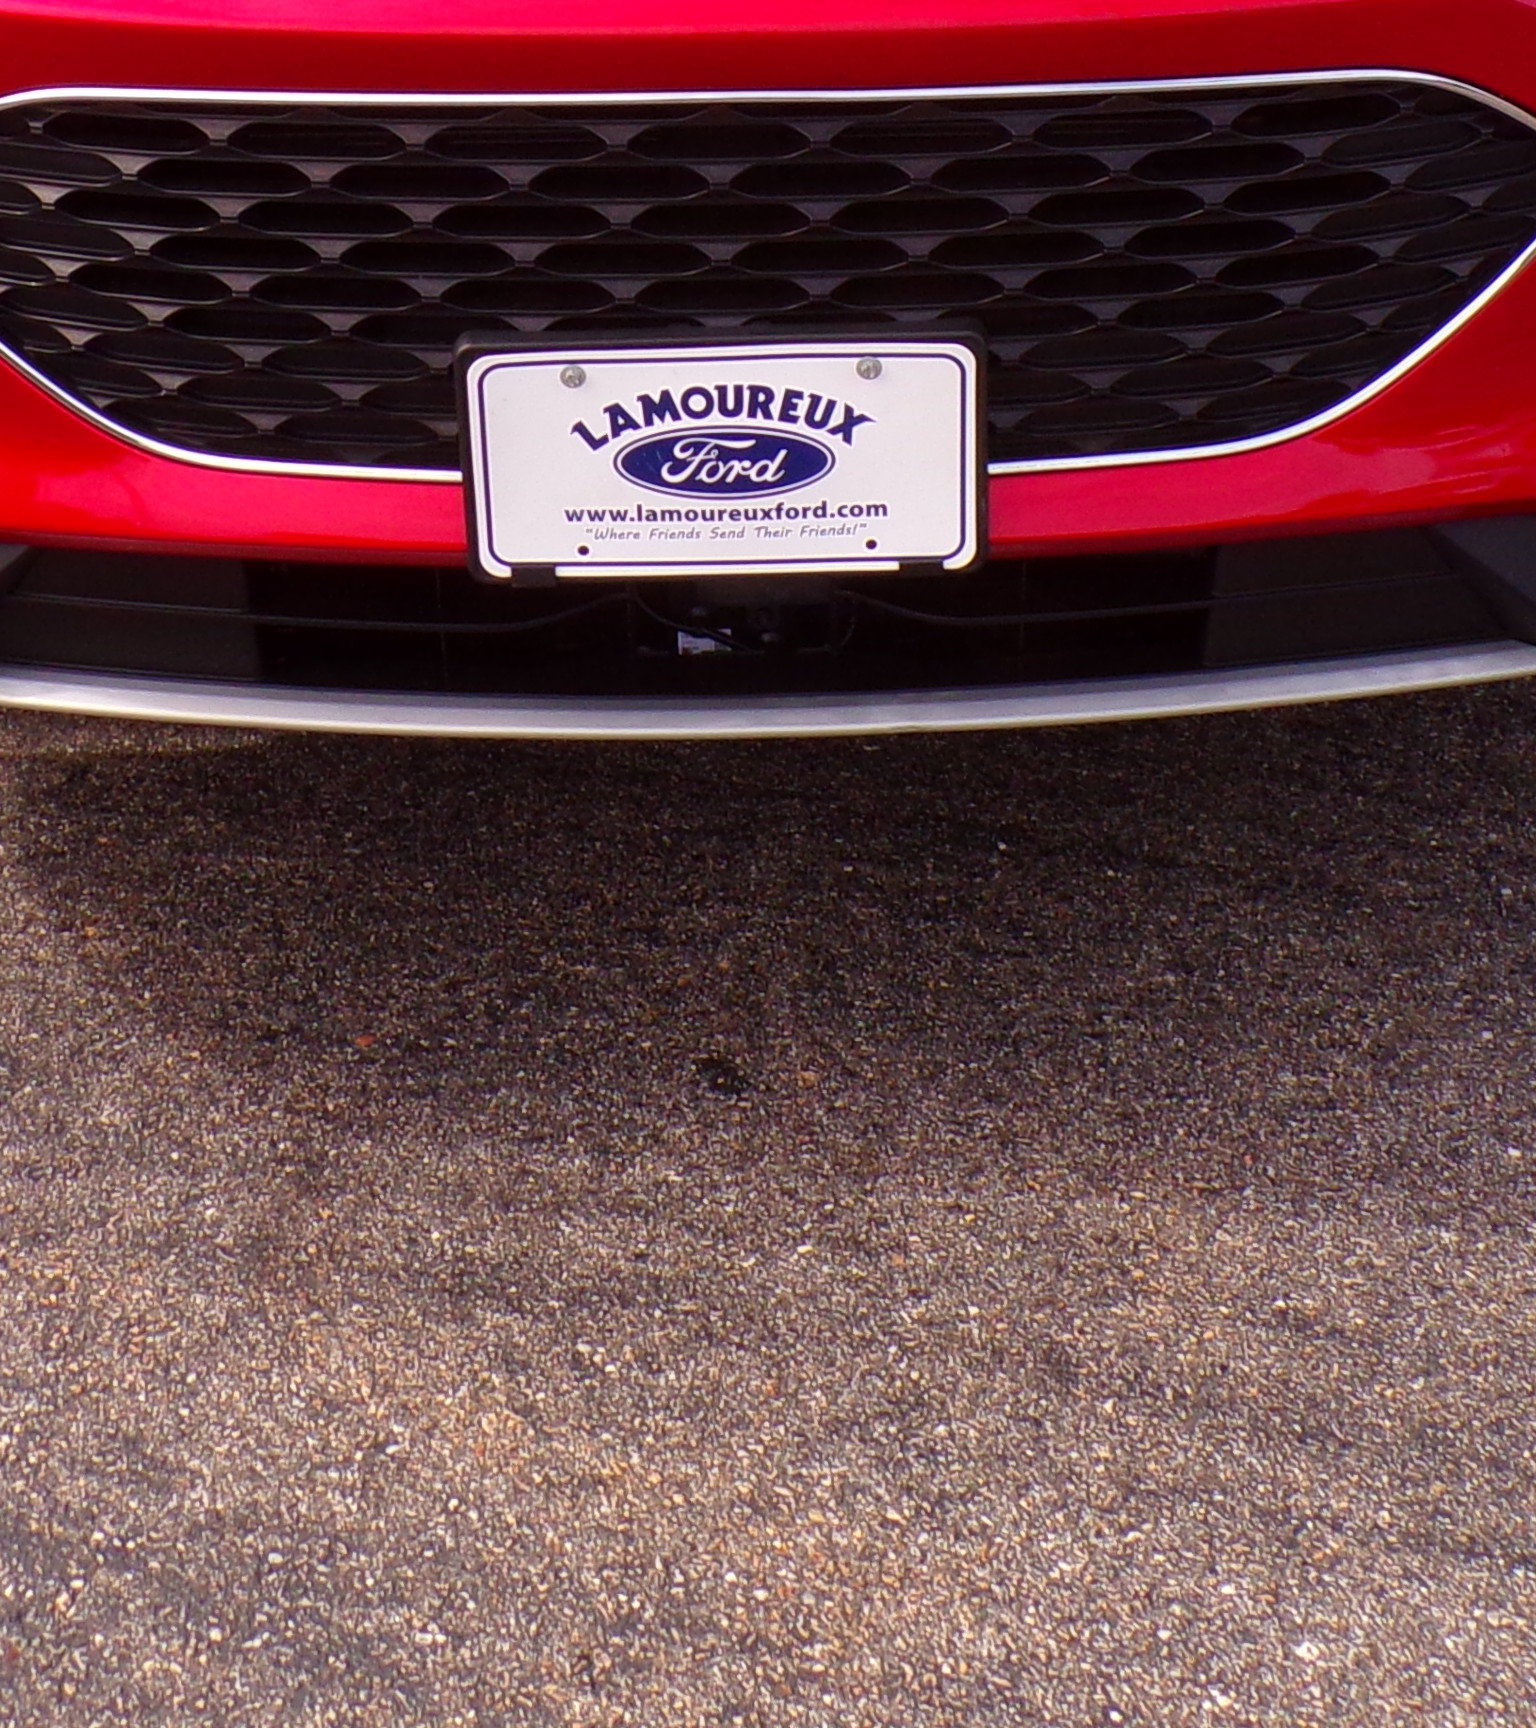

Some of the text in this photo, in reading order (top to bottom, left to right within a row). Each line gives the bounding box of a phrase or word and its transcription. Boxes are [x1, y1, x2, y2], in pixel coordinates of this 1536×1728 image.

[570, 383, 877, 452] LAMOUREUX
[661, 437, 789, 484] Ford
[564, 500, 889, 522] www.lamoureuxford.com
[585, 522, 867, 540] "Where Friends Send Their Friends!"
